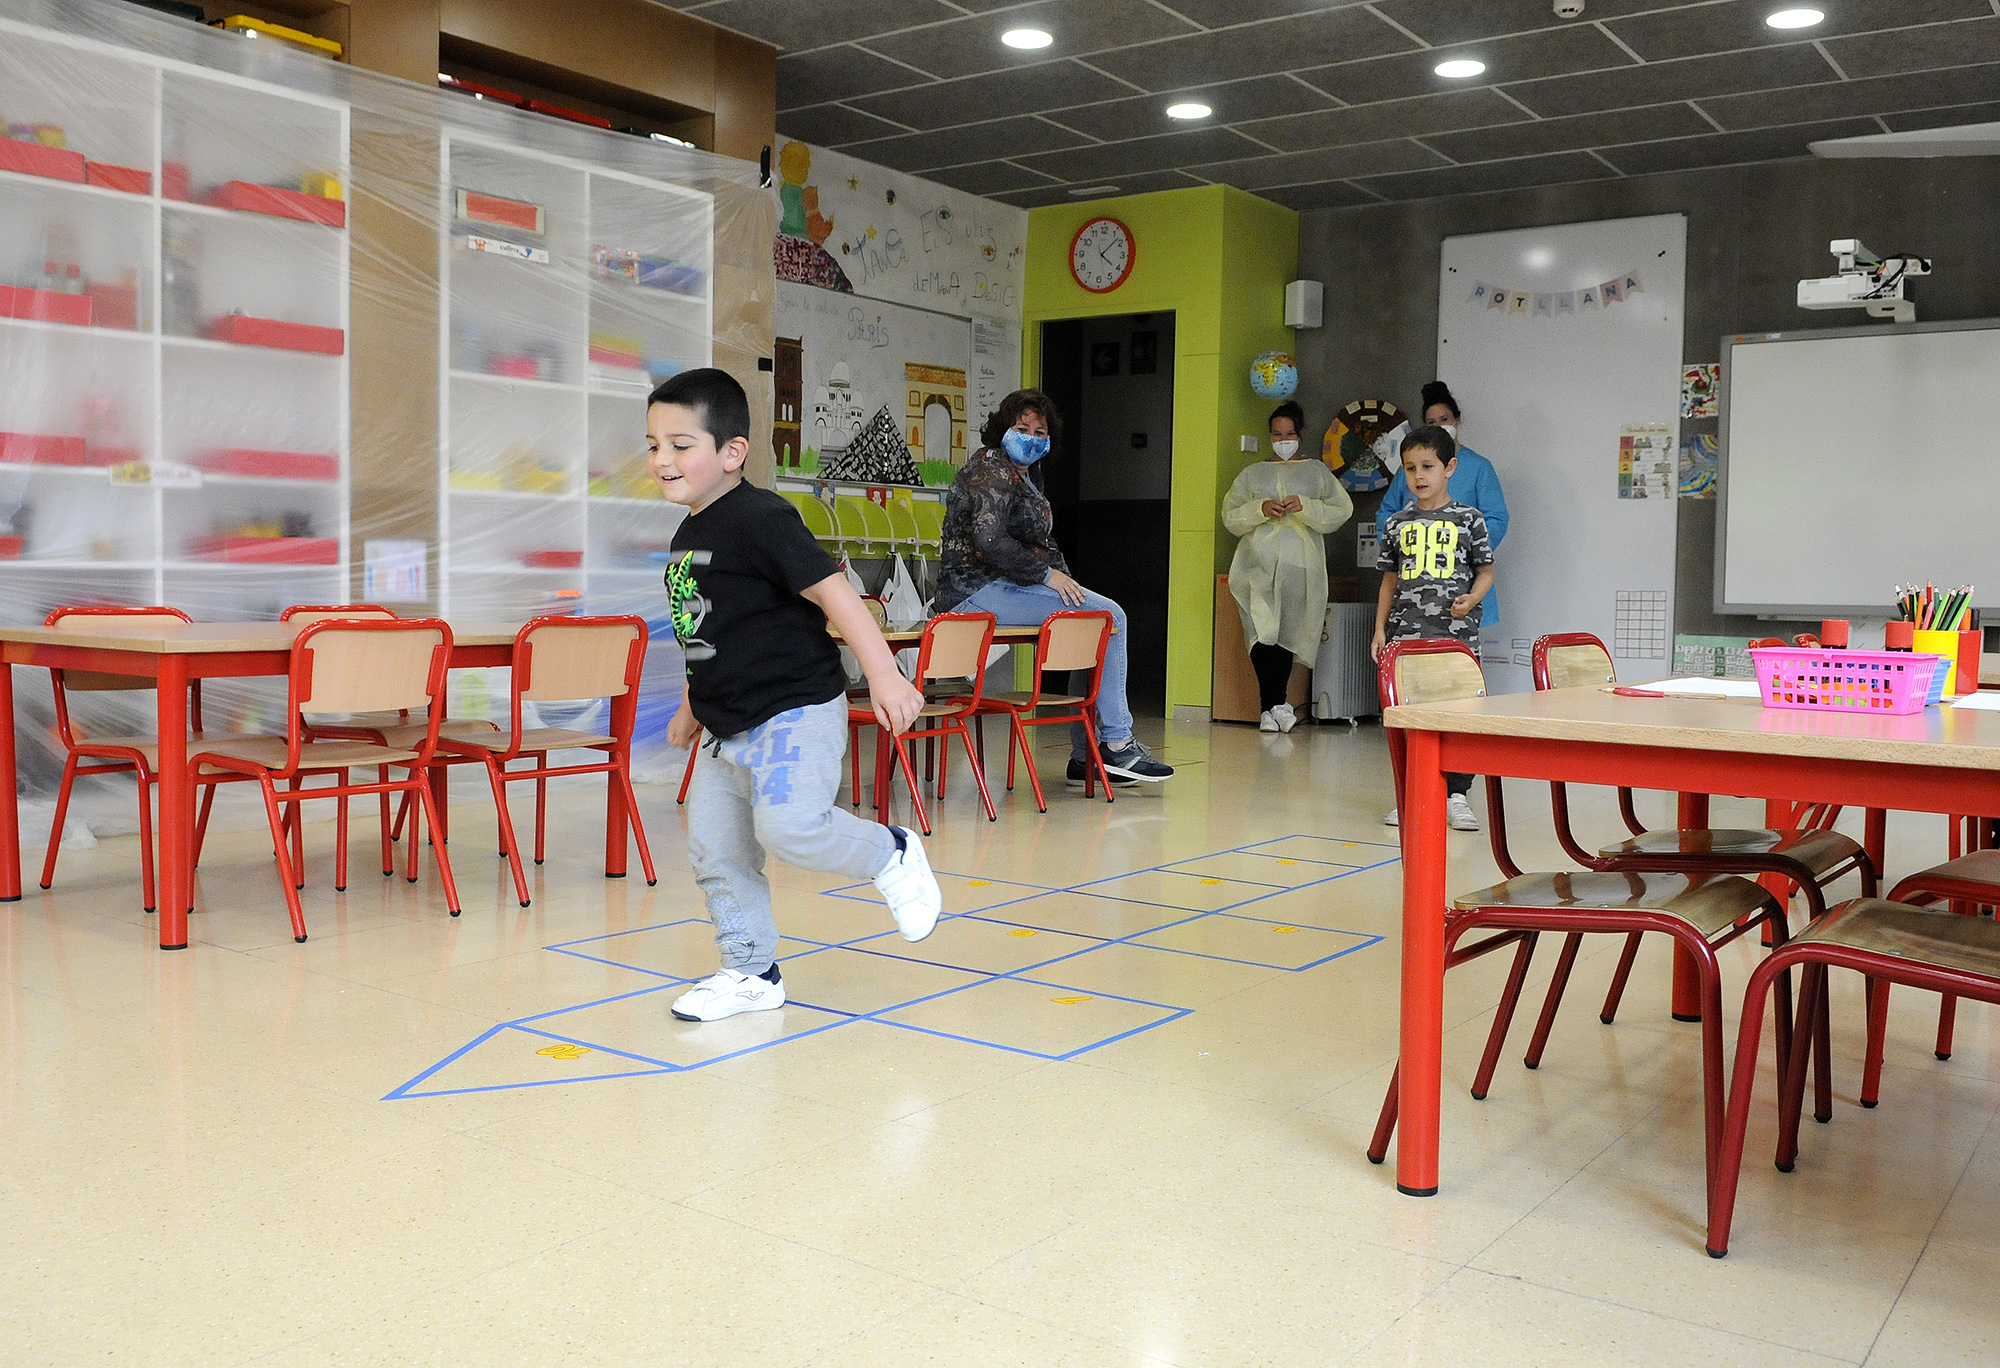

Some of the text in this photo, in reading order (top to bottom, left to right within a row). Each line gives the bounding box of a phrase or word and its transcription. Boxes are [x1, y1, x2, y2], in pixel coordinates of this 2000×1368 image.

[1107, 272, 1112, 280] 5
[1475, 277, 1636, 309] ROTLLANA
[1408, 531, 1447, 542] L A
[1400, 520, 1458, 580] 98
